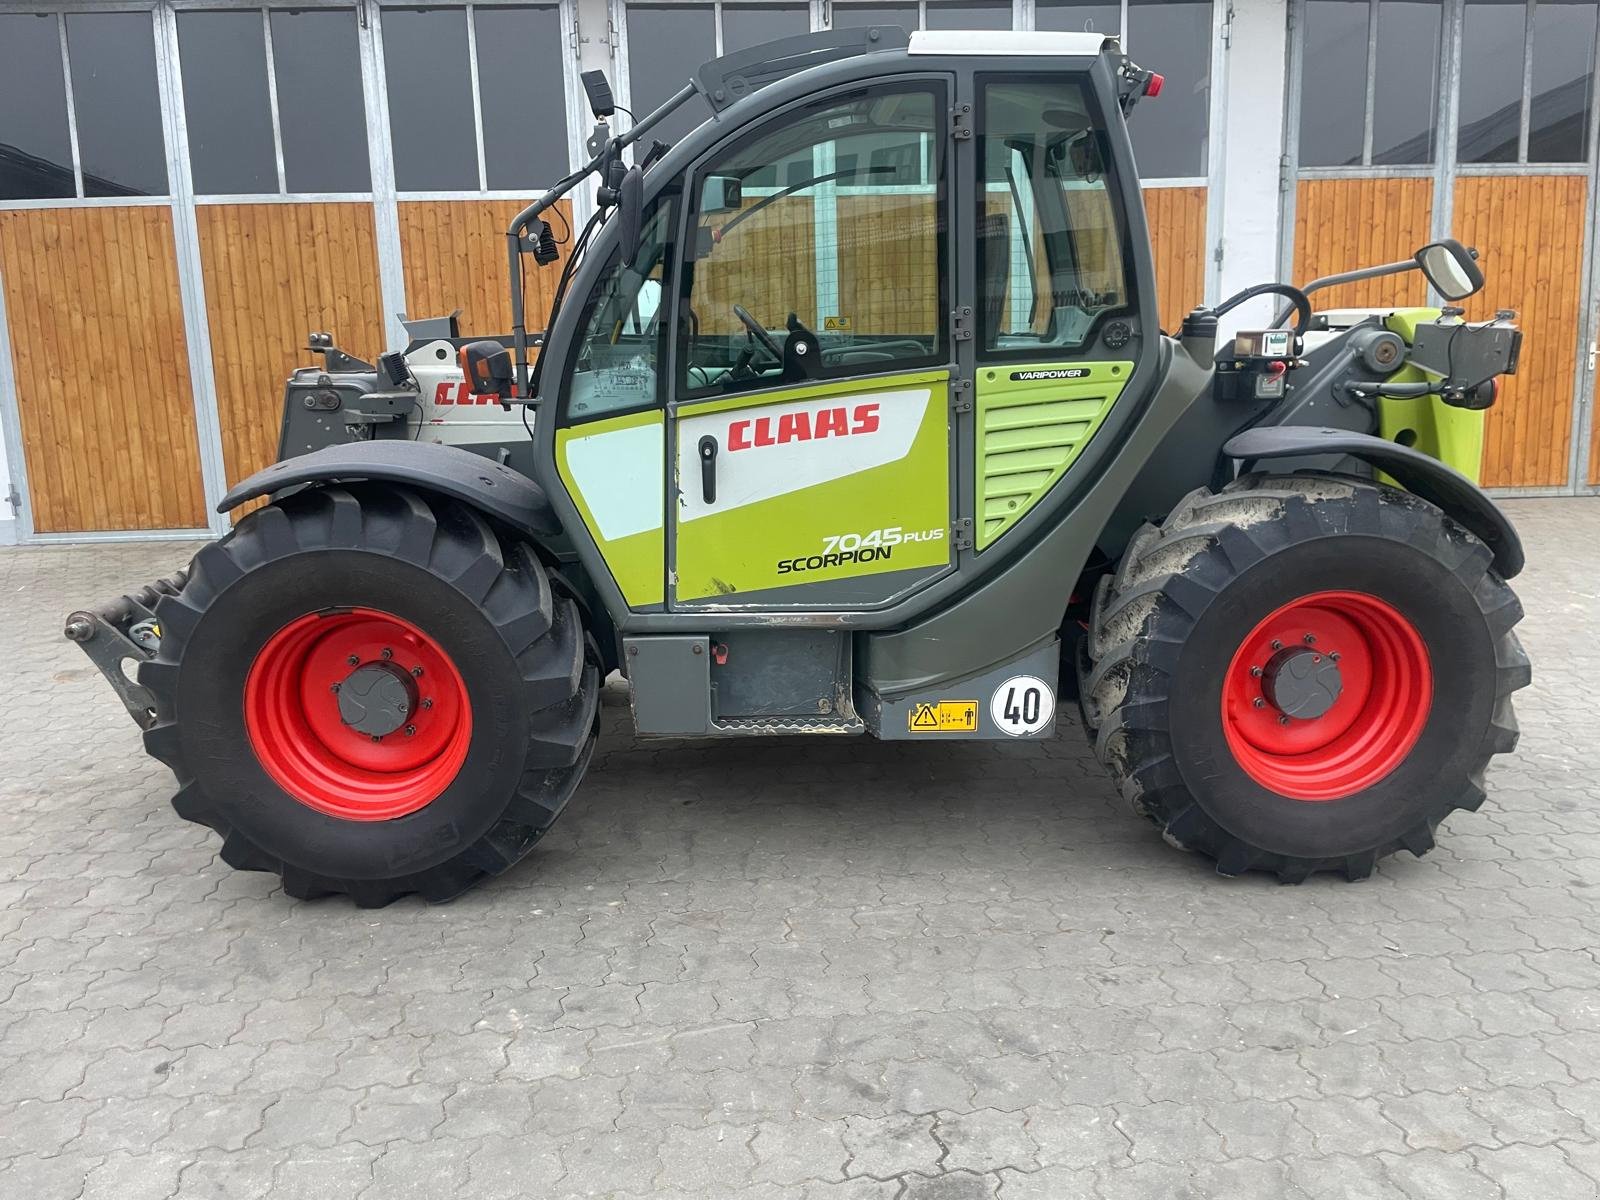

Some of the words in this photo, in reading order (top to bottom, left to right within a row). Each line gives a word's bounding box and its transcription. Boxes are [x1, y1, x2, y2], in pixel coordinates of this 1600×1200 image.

[1018, 369, 1082, 380] VARIPOWER
[727, 403, 880, 452] CLAAS
[822, 526, 902, 555] 7045
[903, 528, 944, 544] PLUS
[777, 546, 892, 574] SCORPION
[1003, 687, 1041, 725] 40
